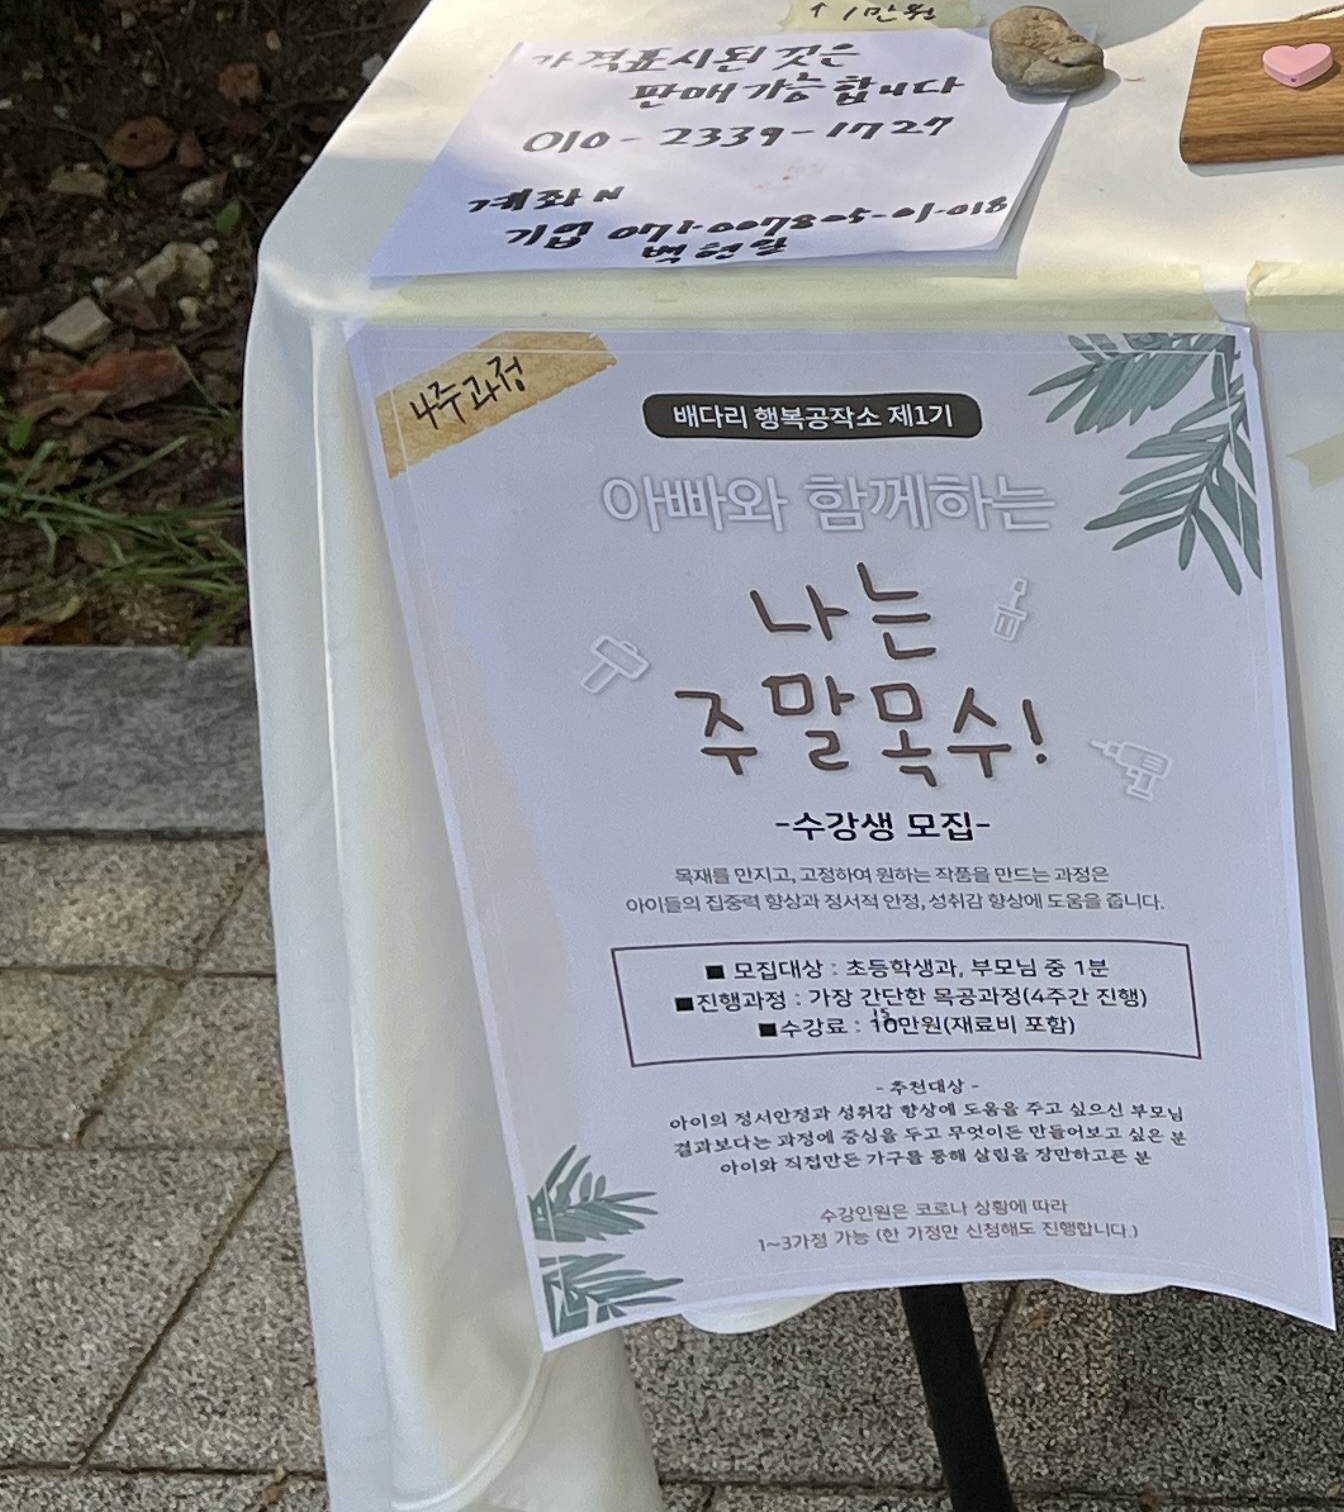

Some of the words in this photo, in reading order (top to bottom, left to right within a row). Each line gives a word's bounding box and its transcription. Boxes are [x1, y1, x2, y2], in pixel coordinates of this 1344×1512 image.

[672, 403, 749, 429] 배다리
[753, 405, 882, 430] 행복공작소
[887, 402, 953, 428] 제1기
[604, 473, 789, 533] 아빠와
[805, 472, 1055, 532] 함께하는
[750, 561, 938, 660] 나는
[675, 866, 731, 885] 목재를
[733, 865, 797, 885] 만지고,
[799, 866, 873, 884] 고정하여
[875, 866, 932, 883] 원하는
[934, 865, 991, 883] 작품을
[993, 865, 1050, 883] 만드는
[1054, 865, 1110, 883] 과정은
[625, 894, 702, 914] 아이들의
[704, 893, 761, 912] 집중력
[764, 891, 820, 911] 향상과
[824, 892, 880, 910] 정서적
[882, 892, 926, 911] 안정,
[928, 891, 983, 910] 성취감
[987, 891, 1044, 909] 향상에
[1047, 892, 1102, 910] 도움을
[1106, 892, 1166, 911] 줍니다.
[733, 958, 824, 981] 모집대상
[846, 957, 964, 979] 초등학생과,
[971, 957, 1037, 977] 부모님
[1044, 957, 1067, 978] 중
[1073, 957, 1110, 977] 1분
[697, 989, 787, 1013] 진행과정
[808, 987, 853, 1008] 가장
[859, 986, 927, 1008] 간단한
[933, 986, 1089, 1007] 목공과정(4주간
[1096, 986, 1148, 1008] 진행)
[780, 1016, 848, 1038] 수강료
[1024, 1015, 1076, 1035] 포함)
[819, 1202, 909, 1224] 수강인원은
[915, 1199, 968, 1217] 코로나
[973, 1197, 1028, 1217] 상황에
[1031, 1198, 1068, 1215] 따라
[833, 1229, 870, 1246] 가능
[875, 1225, 900, 1244] (한
[906, 1223, 959, 1241] 가정만
[965, 1220, 1036, 1239] 신청해도
